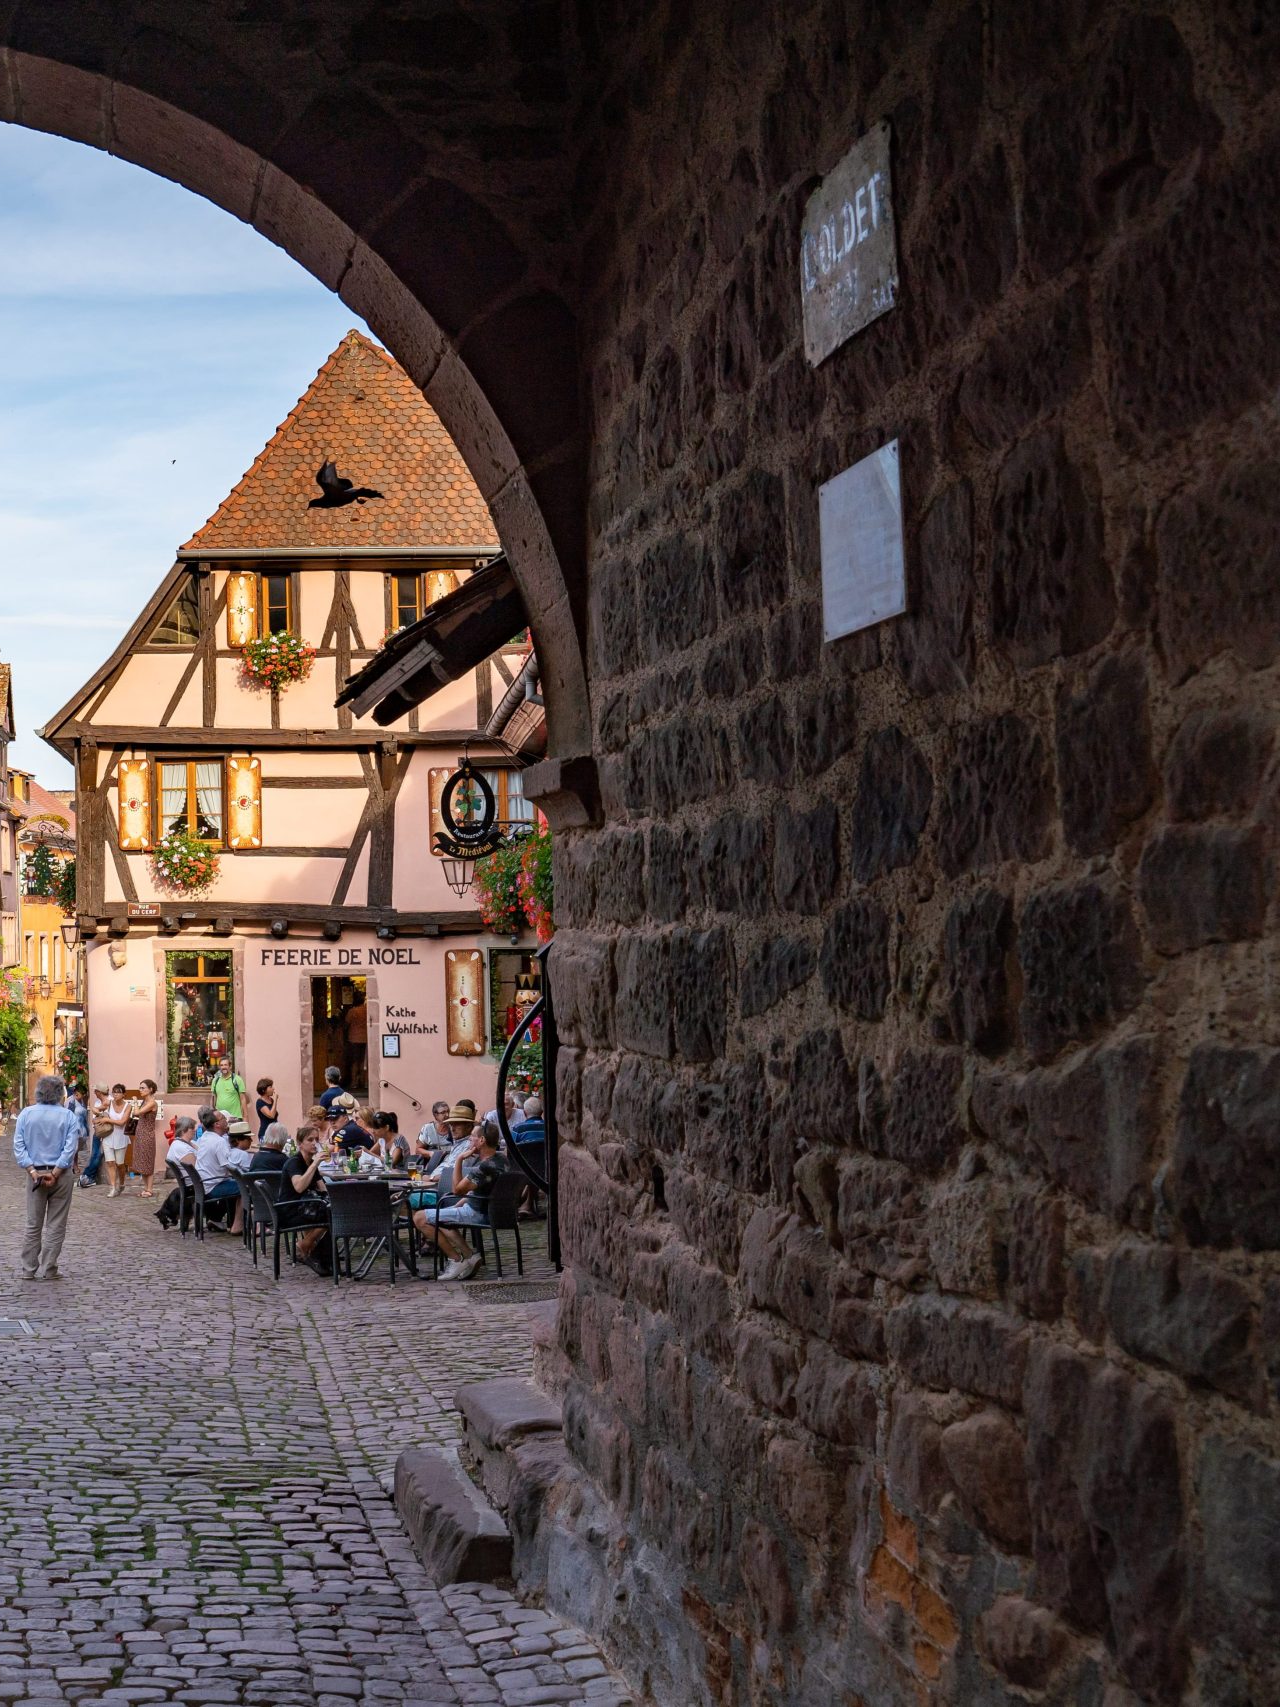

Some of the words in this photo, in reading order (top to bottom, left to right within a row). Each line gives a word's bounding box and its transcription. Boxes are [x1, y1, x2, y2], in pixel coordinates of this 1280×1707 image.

[453, 828, 484, 838] Restaurant
[261, 948, 331, 966] FEERIE
[338, 948, 362, 965] DE
[369, 948, 420, 965] NOEL
[386, 1005, 416, 1017] Kathe
[386, 1022, 438, 1033] Wohlfahrt
